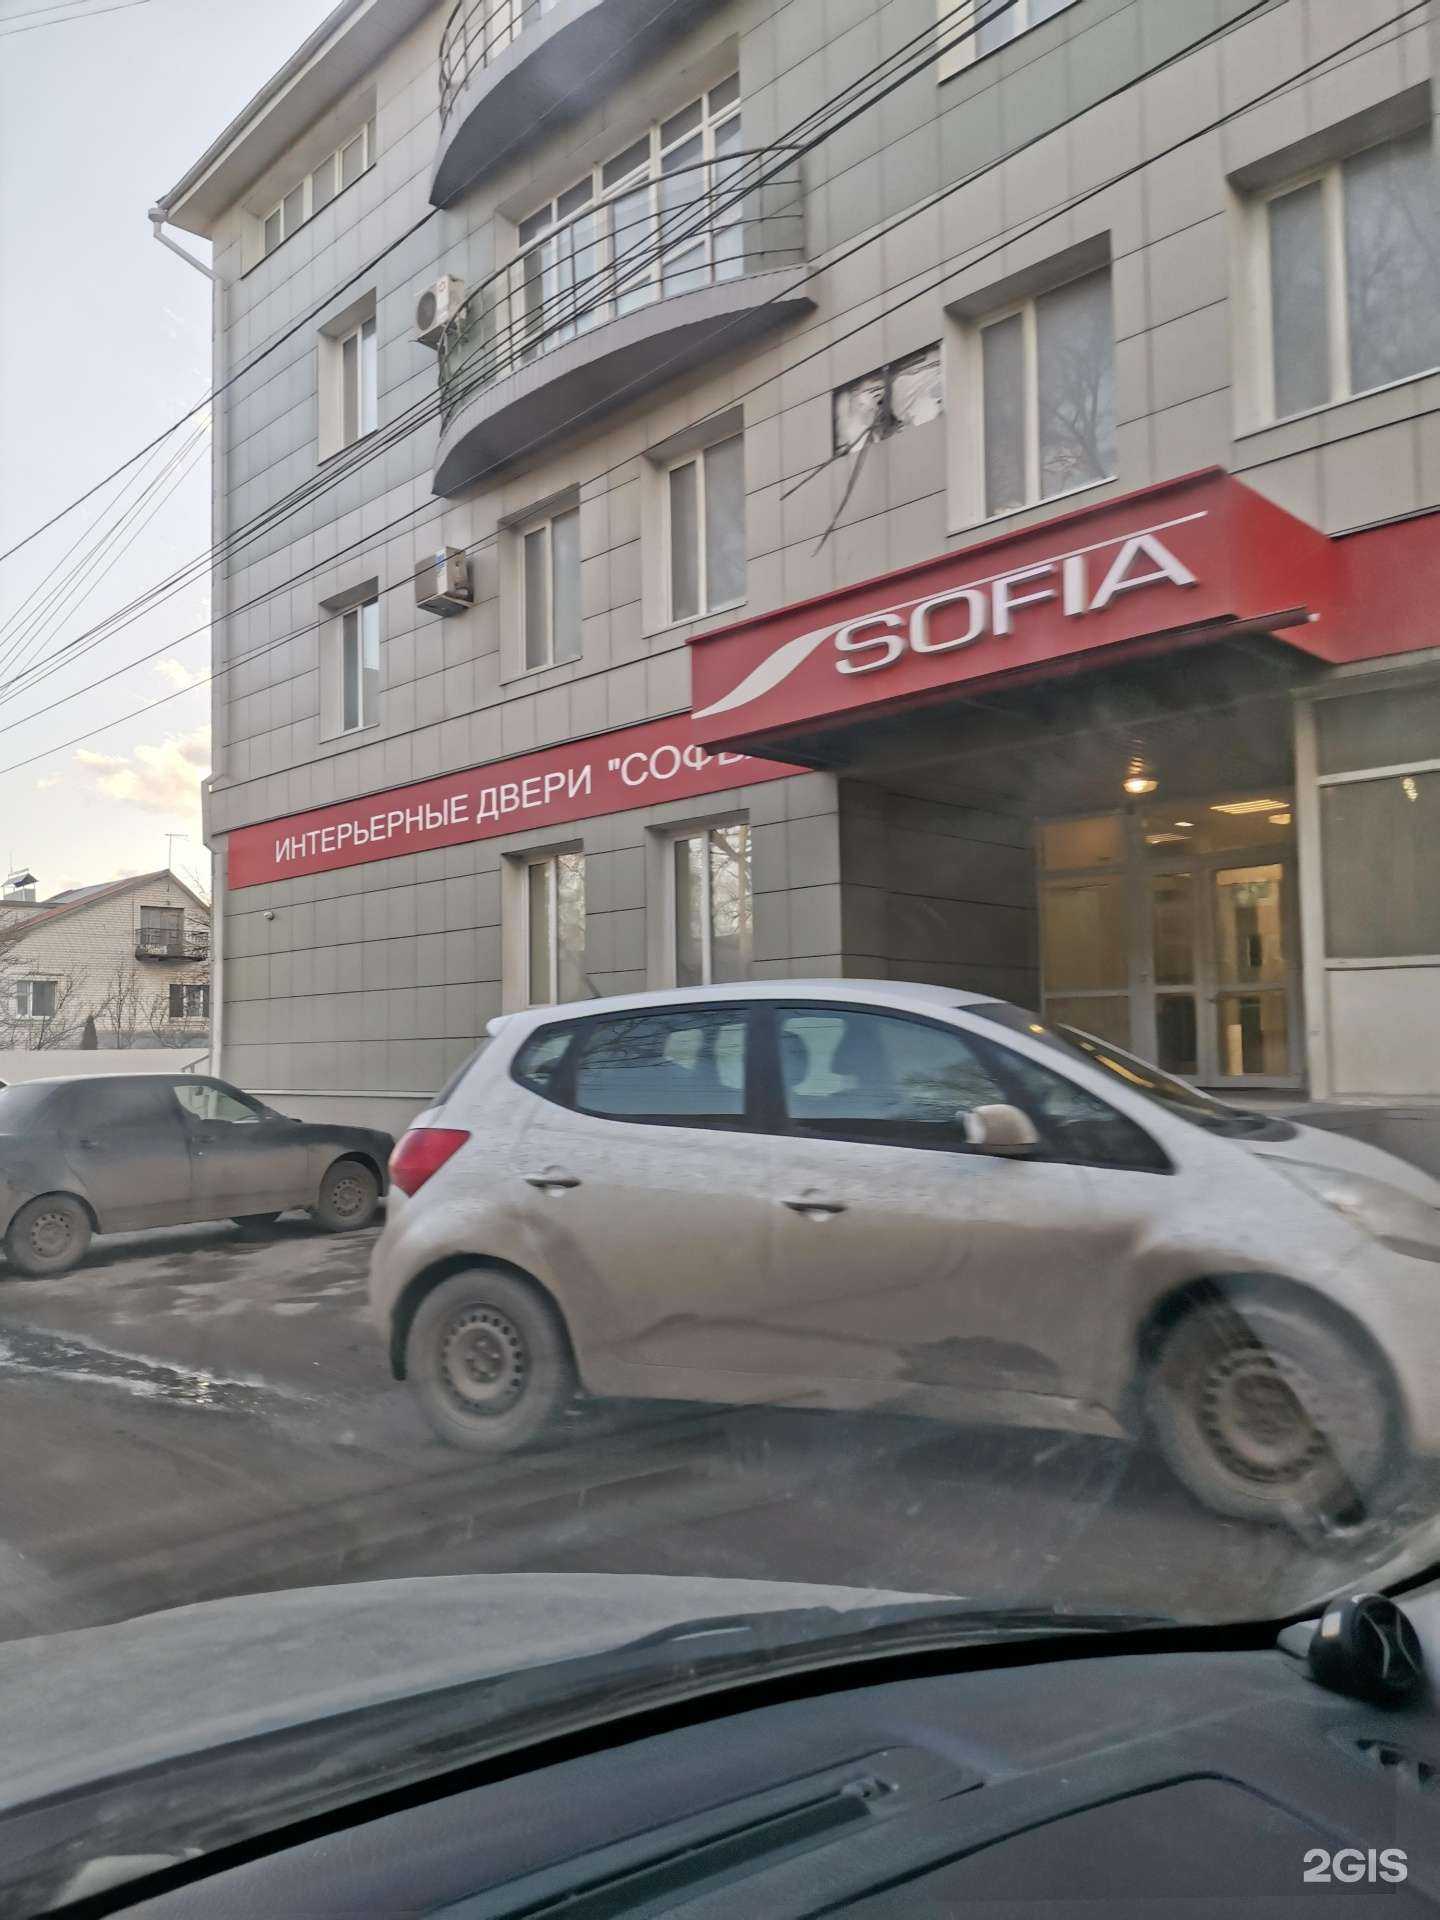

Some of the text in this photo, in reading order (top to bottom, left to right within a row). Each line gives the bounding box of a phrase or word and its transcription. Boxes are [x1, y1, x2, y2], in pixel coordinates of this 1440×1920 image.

[834, 533, 1199, 675] SOFIA
[274, 794, 469, 863] ИНТЕРЬЕРНЫЕ
[475, 764, 593, 825] ДВЕРИ
